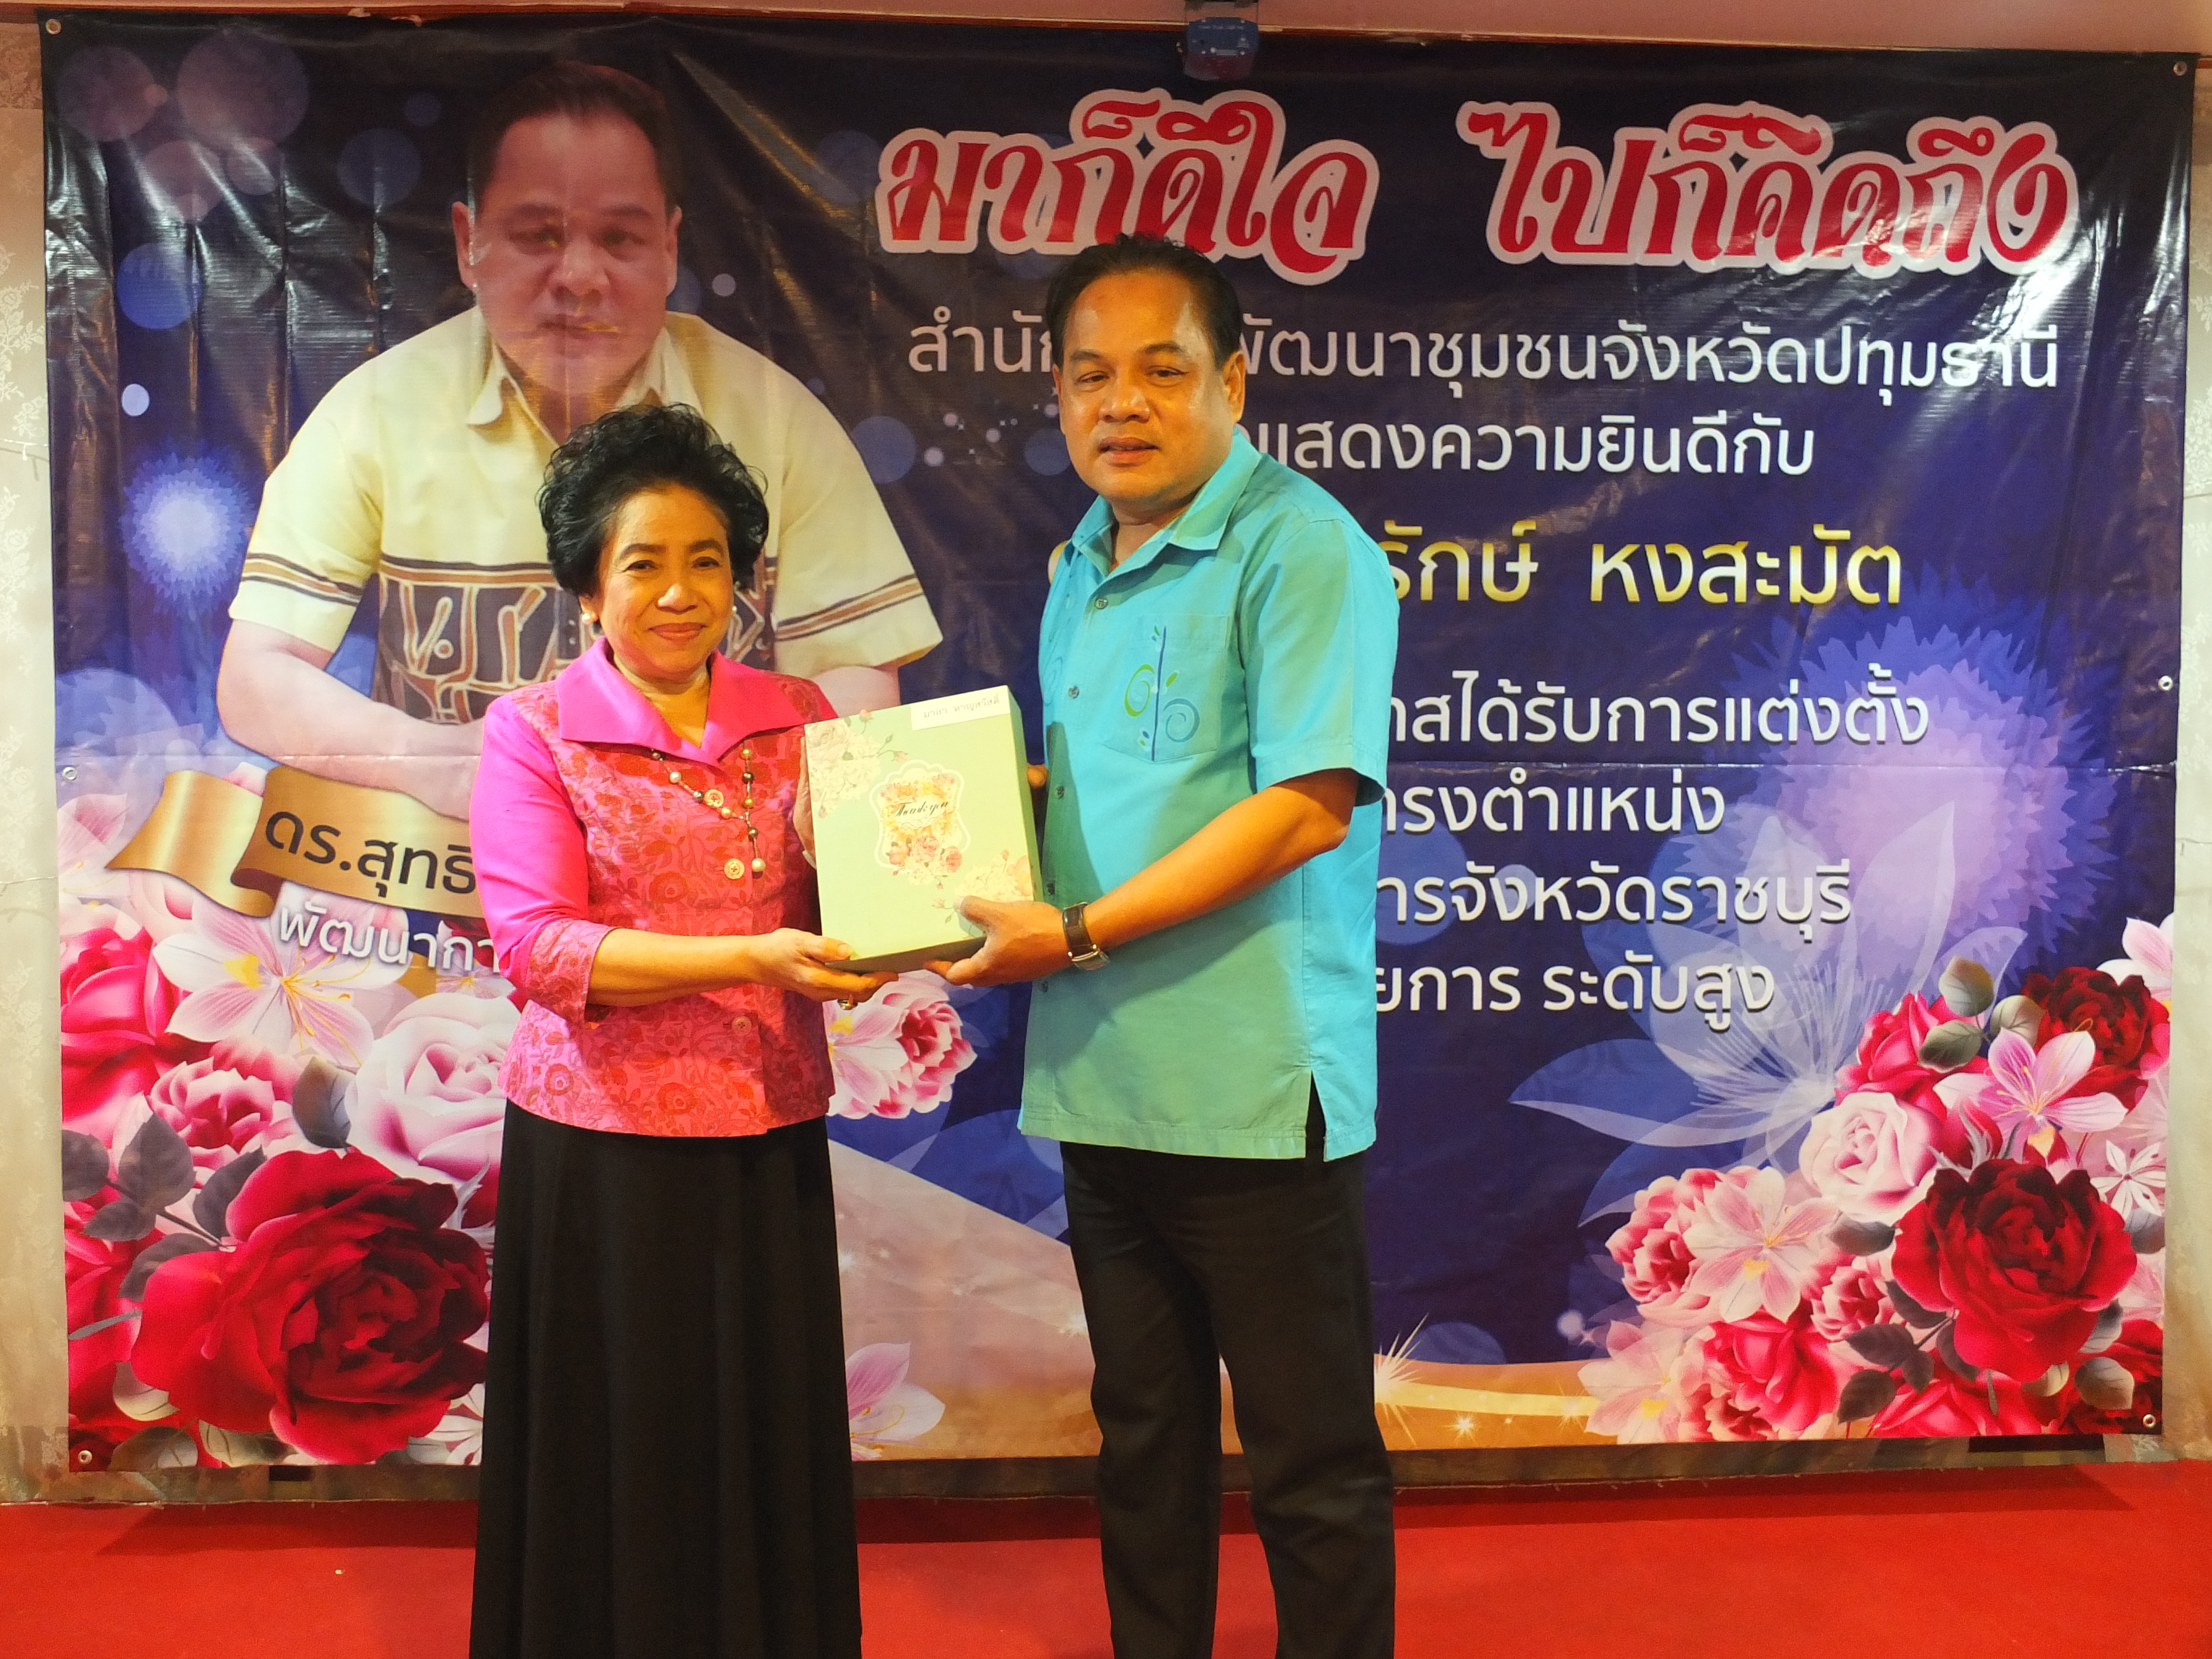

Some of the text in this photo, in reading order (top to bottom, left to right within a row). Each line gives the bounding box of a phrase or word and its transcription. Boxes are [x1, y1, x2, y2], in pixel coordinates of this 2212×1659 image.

[886, 98, 2069, 274] มาก็ดีใจ ไปก็คิดถึง
[1239, 409, 1815, 477] แสดงความยินดีกับ
[1590, 523, 1901, 605] หงสะมัต
[1543, 950, 1776, 1030] ระดับสูง
